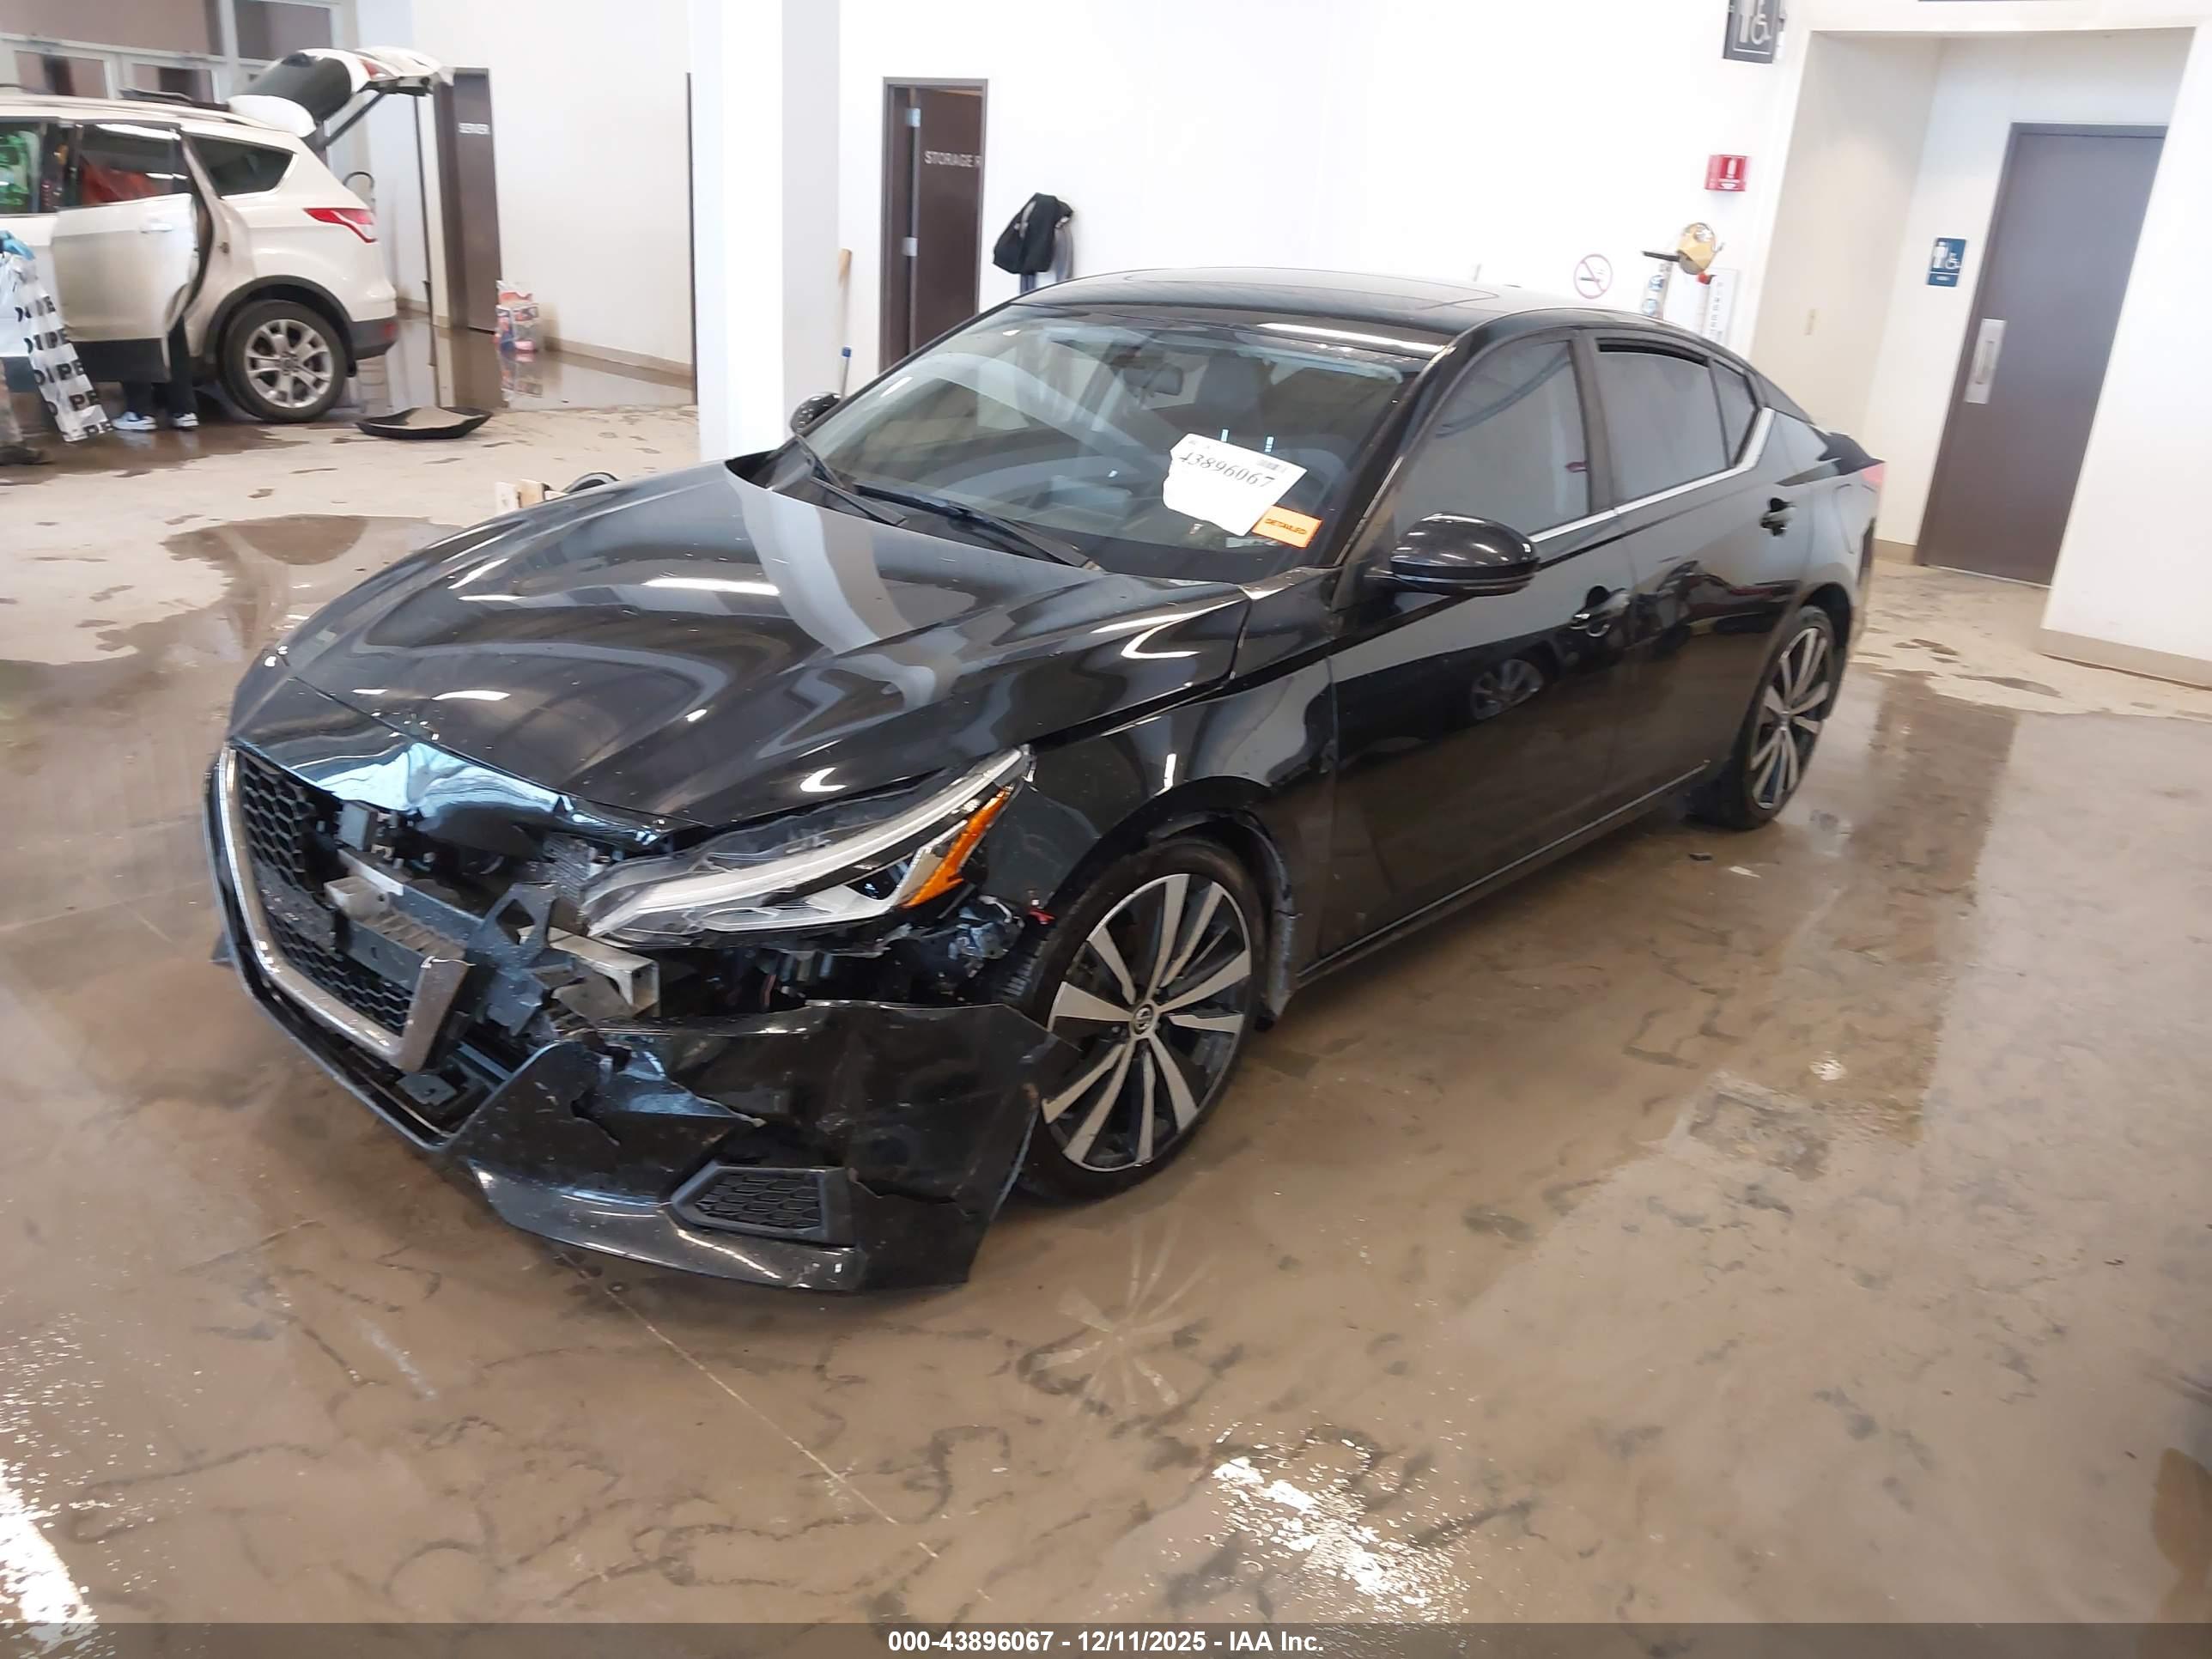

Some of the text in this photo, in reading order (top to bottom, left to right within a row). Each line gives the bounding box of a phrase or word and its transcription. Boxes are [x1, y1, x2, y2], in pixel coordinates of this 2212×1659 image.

[925, 150, 975, 167] STORAGE
[1179, 452, 1275, 488] 43896067
[1264, 518, 1308, 535] DETAILED
